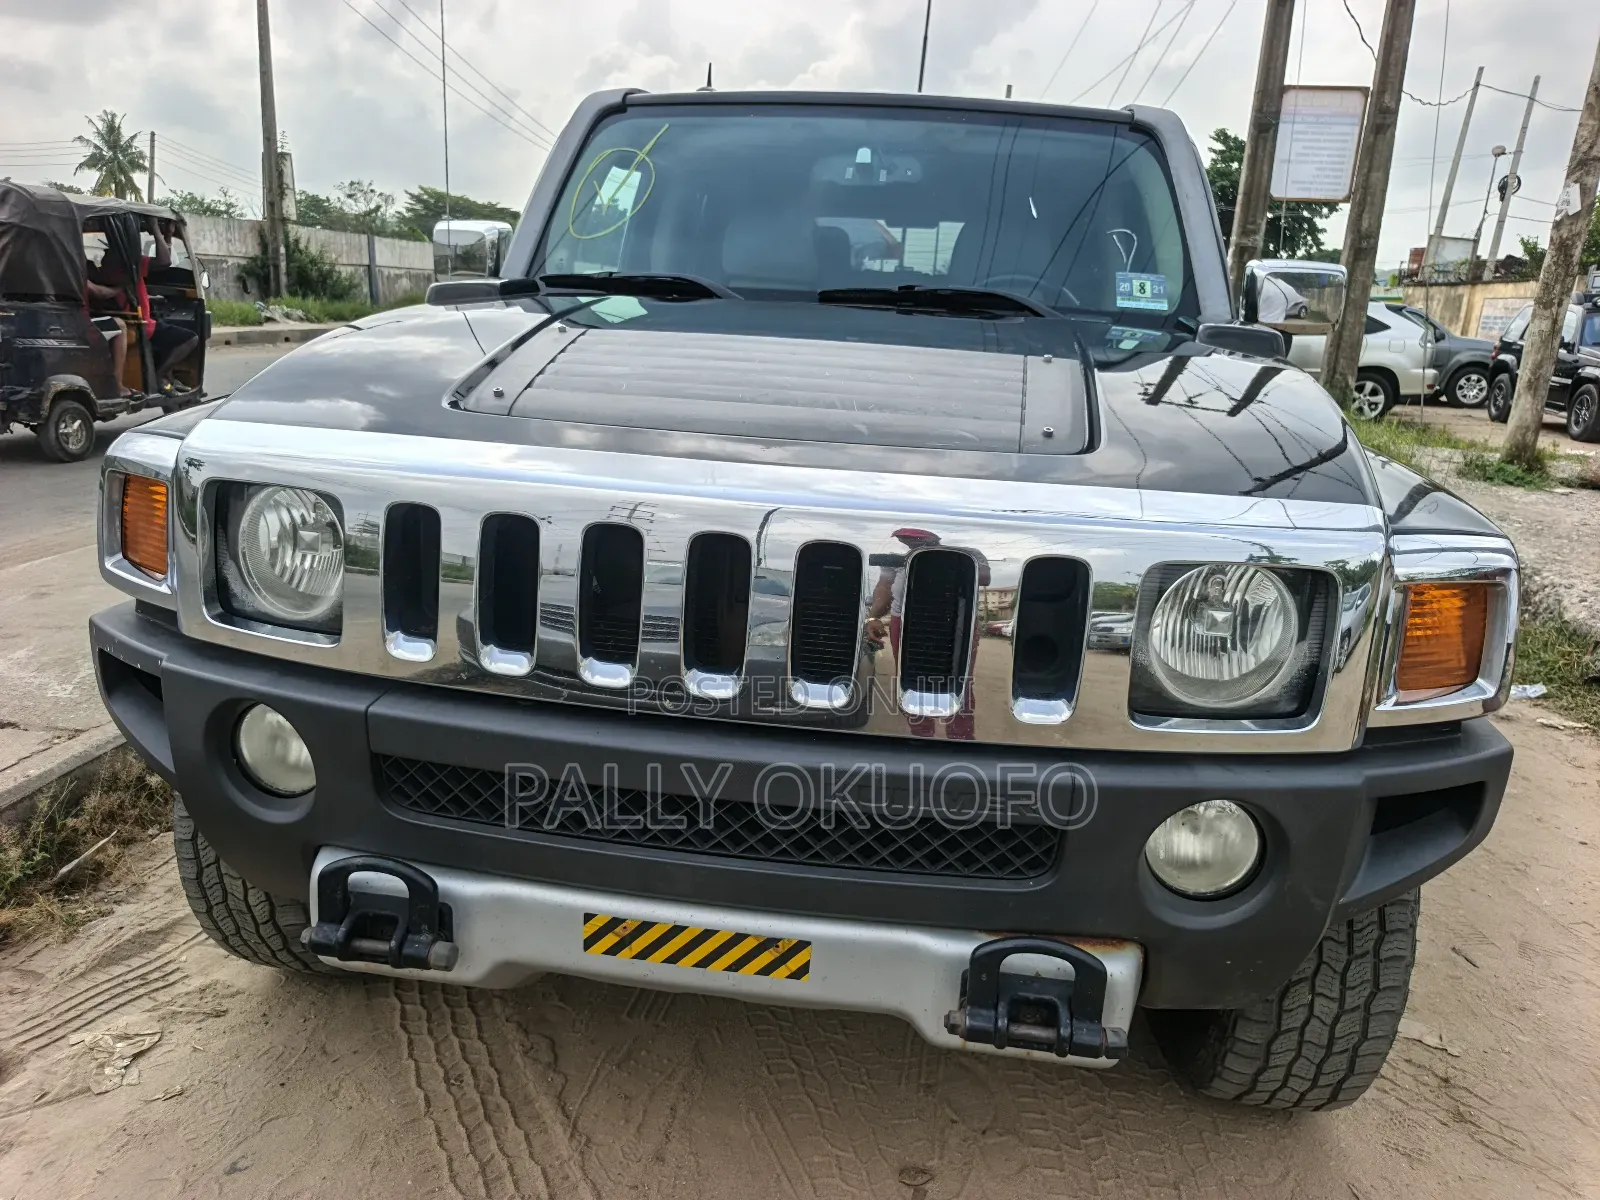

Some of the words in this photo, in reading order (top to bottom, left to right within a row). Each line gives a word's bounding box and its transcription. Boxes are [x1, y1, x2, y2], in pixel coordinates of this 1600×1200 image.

[1119, 282, 1130, 292] 20
[1139, 282, 1146, 295] 8
[1152, 285, 1164, 294] 21
